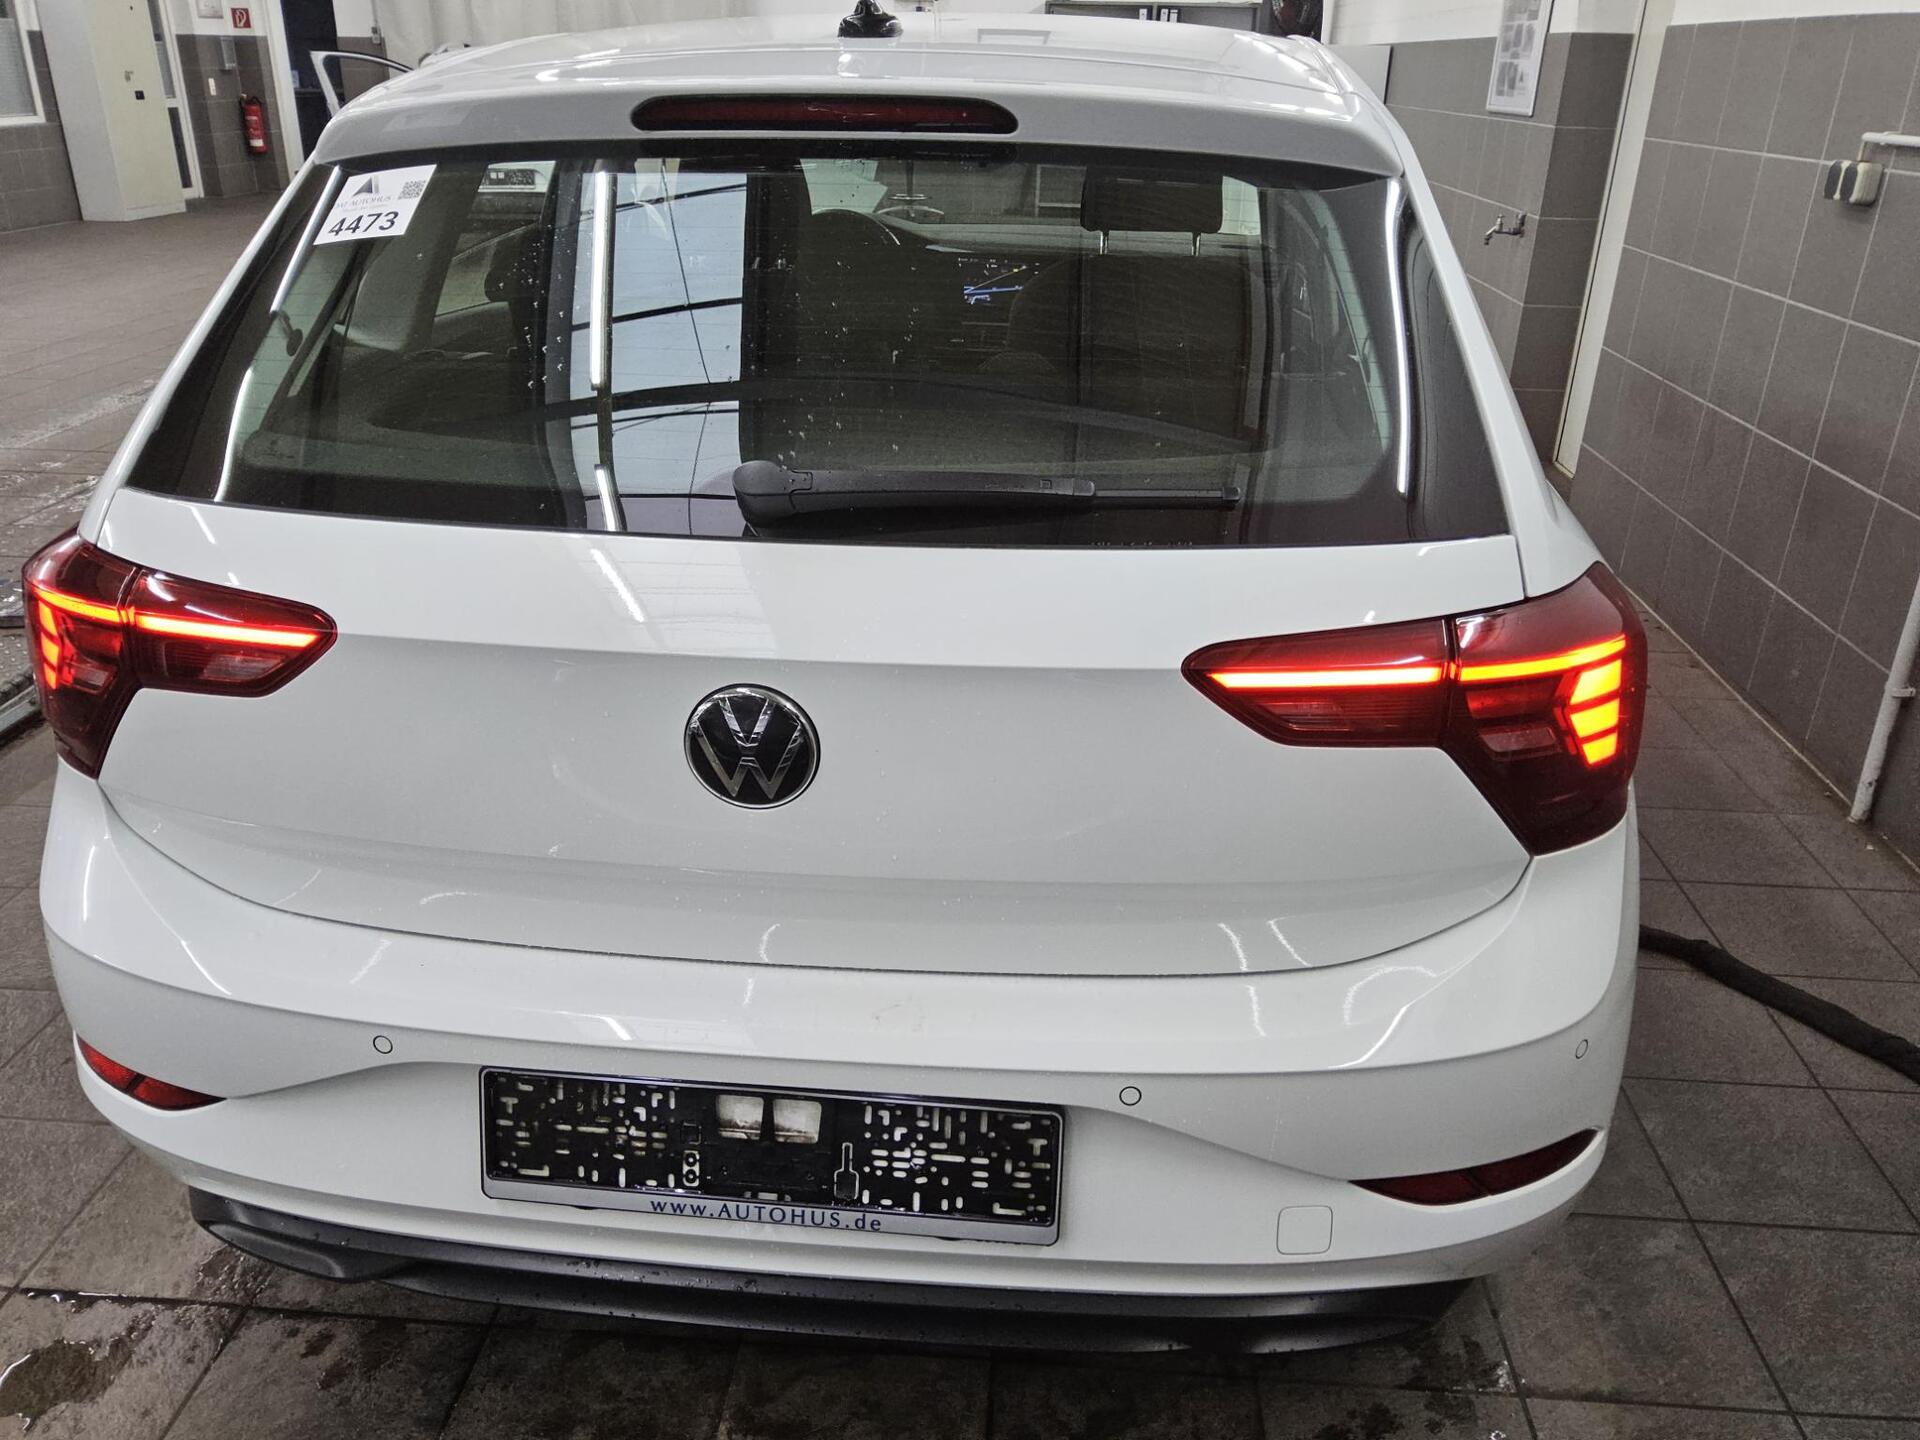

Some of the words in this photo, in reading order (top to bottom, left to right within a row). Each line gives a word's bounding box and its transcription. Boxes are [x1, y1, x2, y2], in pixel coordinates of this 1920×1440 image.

[329, 211, 399, 236] 4473
[692, 695, 807, 801] VW
[650, 1200, 882, 1231] www.AUTOHUS.de
